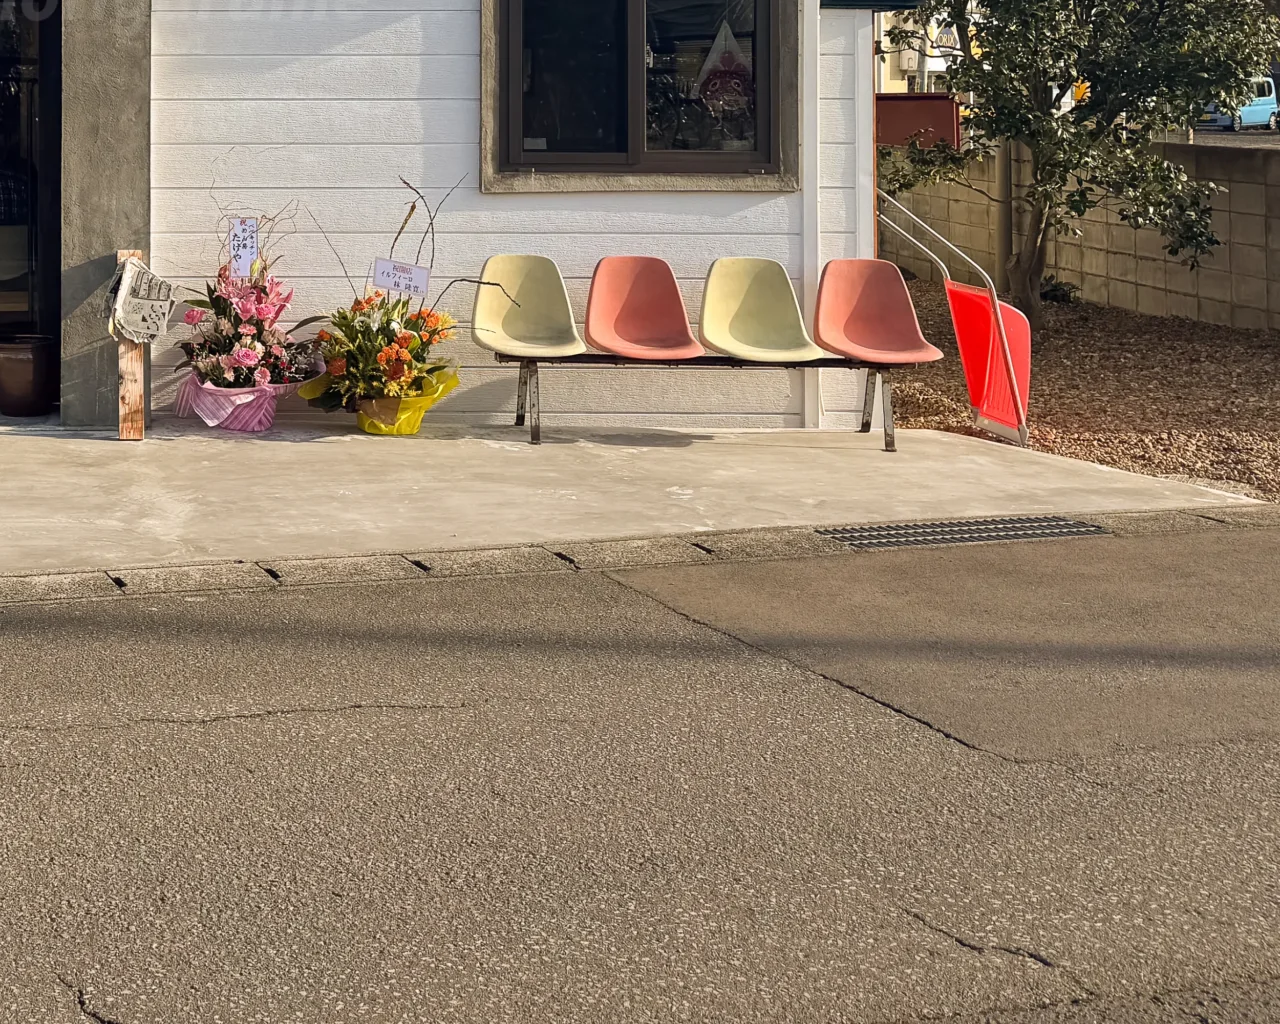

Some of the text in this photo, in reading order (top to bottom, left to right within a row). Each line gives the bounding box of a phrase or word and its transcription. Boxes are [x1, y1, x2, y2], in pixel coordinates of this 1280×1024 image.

[937, 33, 955, 47] ORIX
[232, 232, 242, 263] たけや
[381, 270, 413, 283] イルフィーロ
